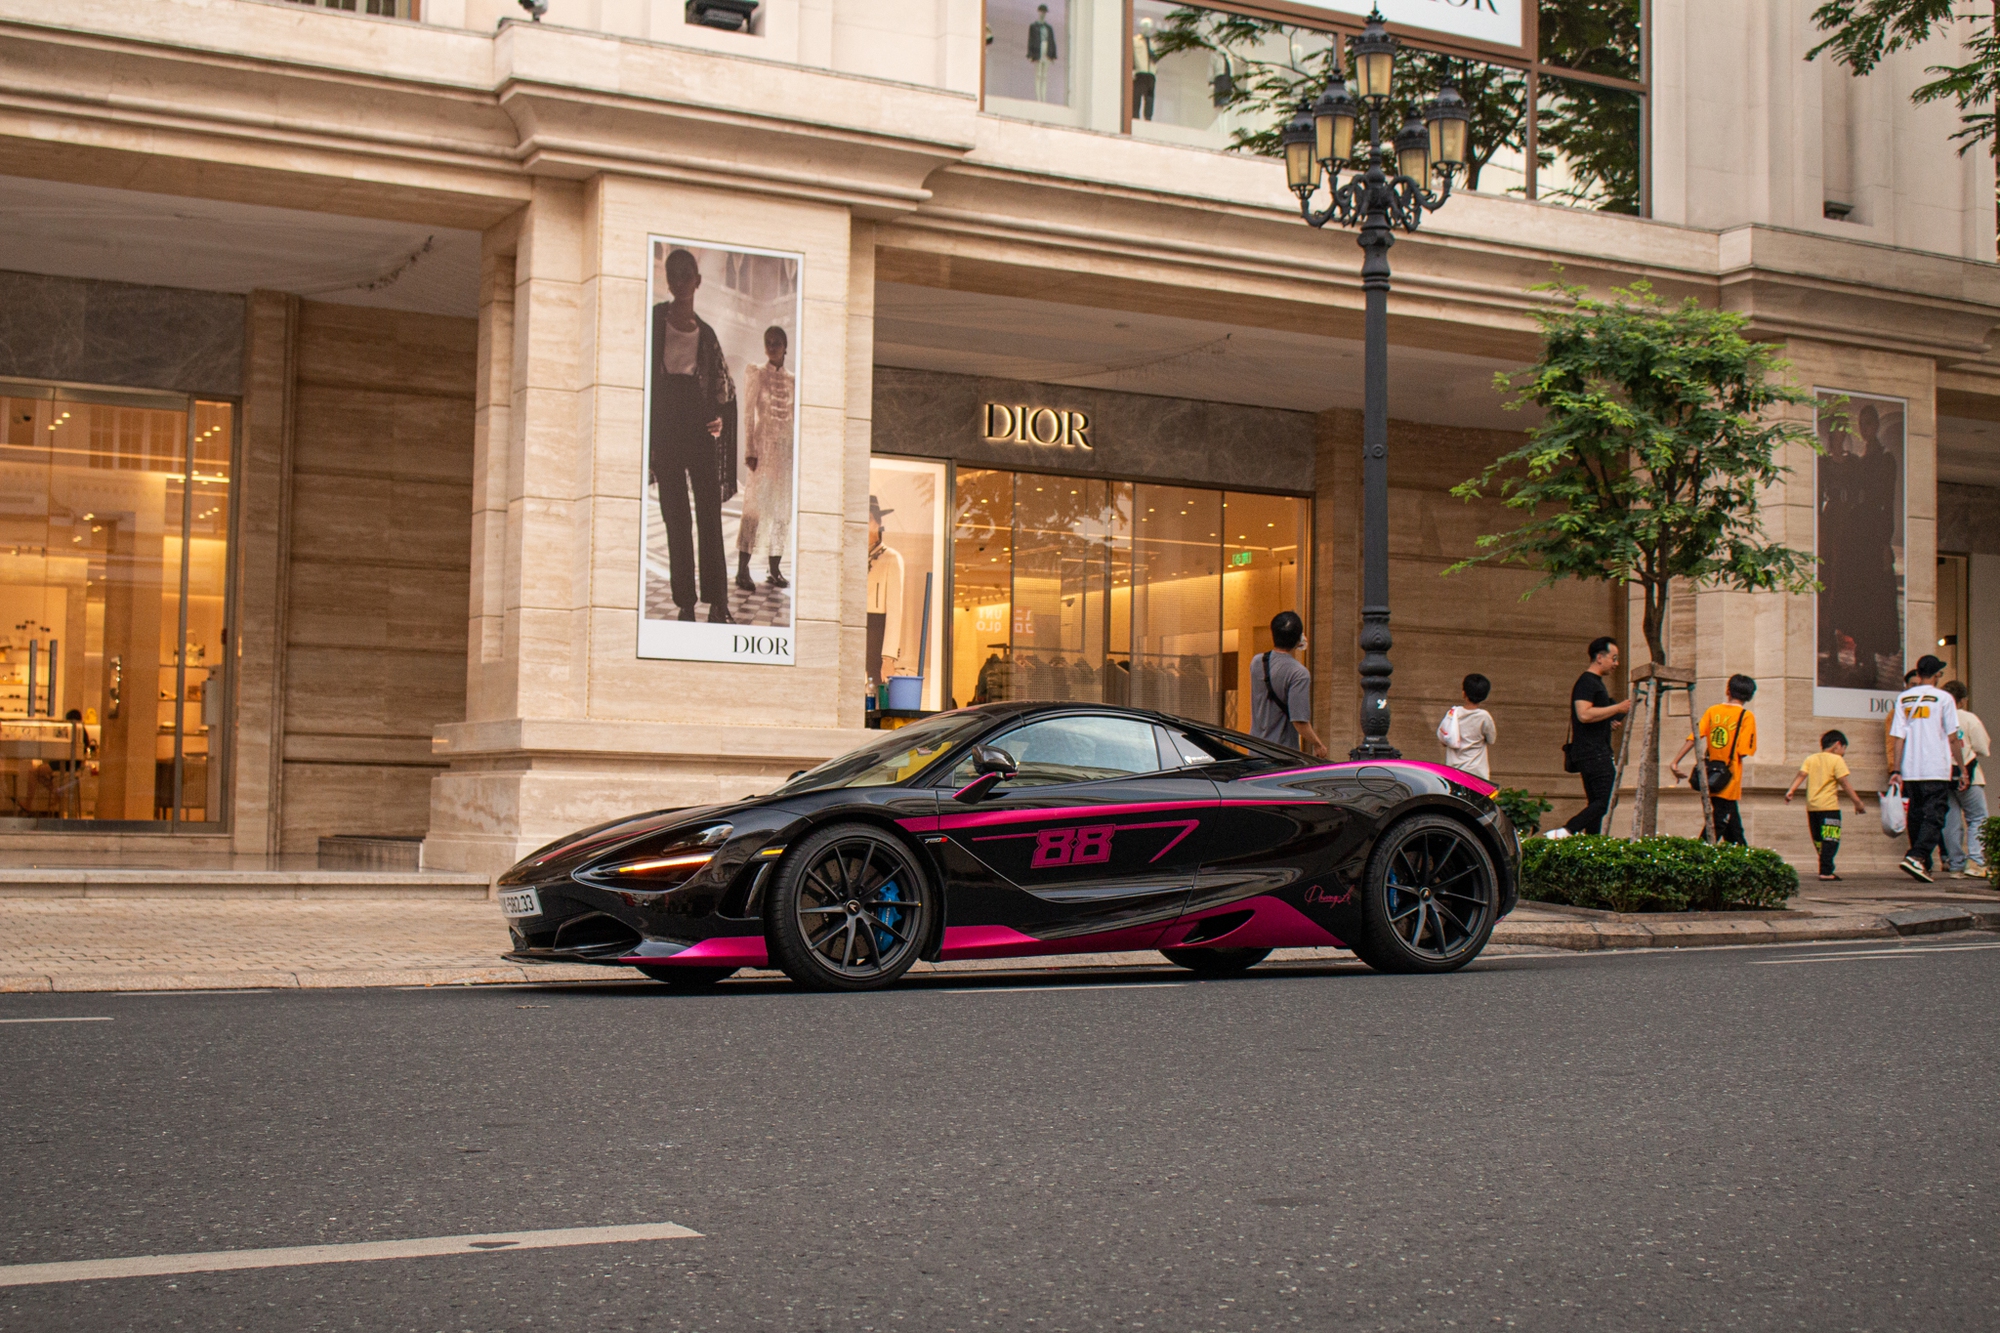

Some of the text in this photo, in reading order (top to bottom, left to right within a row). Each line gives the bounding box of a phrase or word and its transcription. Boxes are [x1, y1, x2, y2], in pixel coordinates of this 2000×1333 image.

[984, 403, 1093, 449] DIOR
[733, 635, 789, 656] DIOR
[1870, 697, 1896, 713] DIO
[1709, 714, 1738, 730] OKU
[1030, 823, 1117, 869] 88
